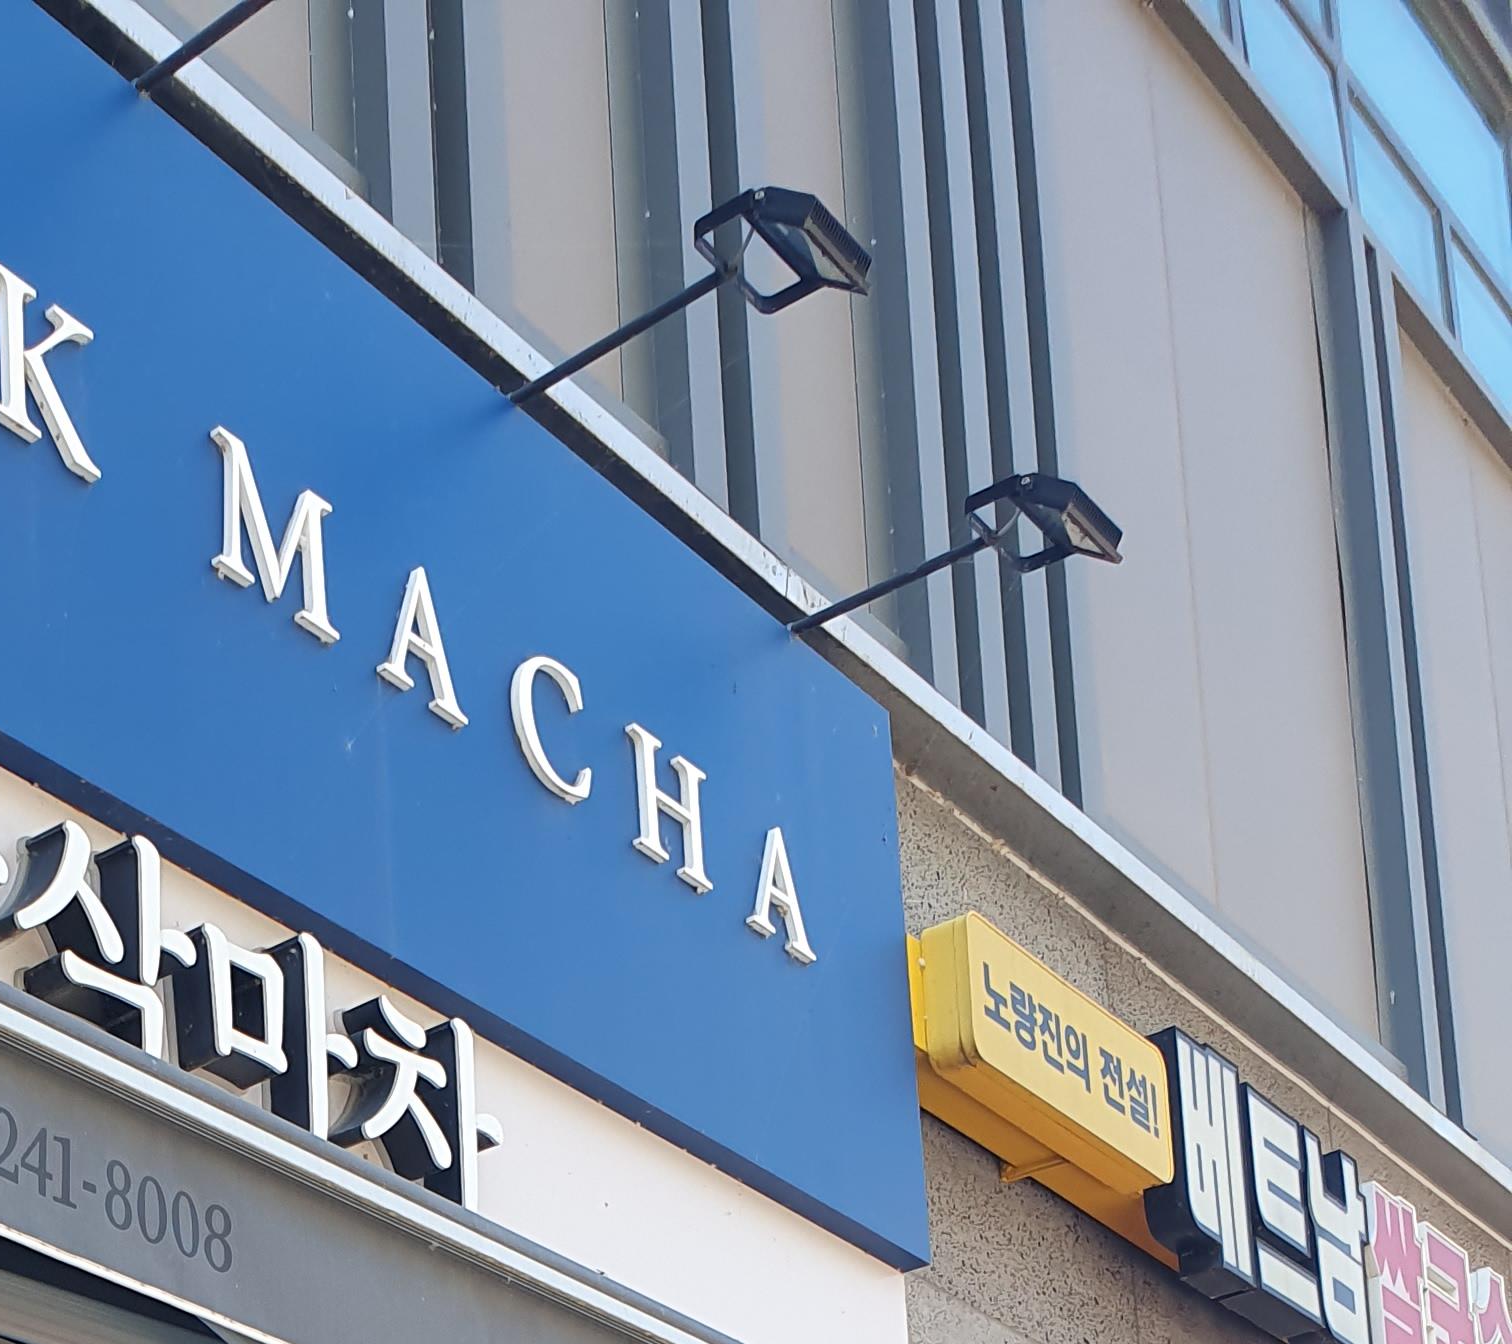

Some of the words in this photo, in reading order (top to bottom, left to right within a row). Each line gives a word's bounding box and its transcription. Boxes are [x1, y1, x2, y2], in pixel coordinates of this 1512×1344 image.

[210, 425, 817, 963] MACHA
[982, 961, 1091, 1093] 노량진의
[1099, 1046, 1160, 1138] 전설!
